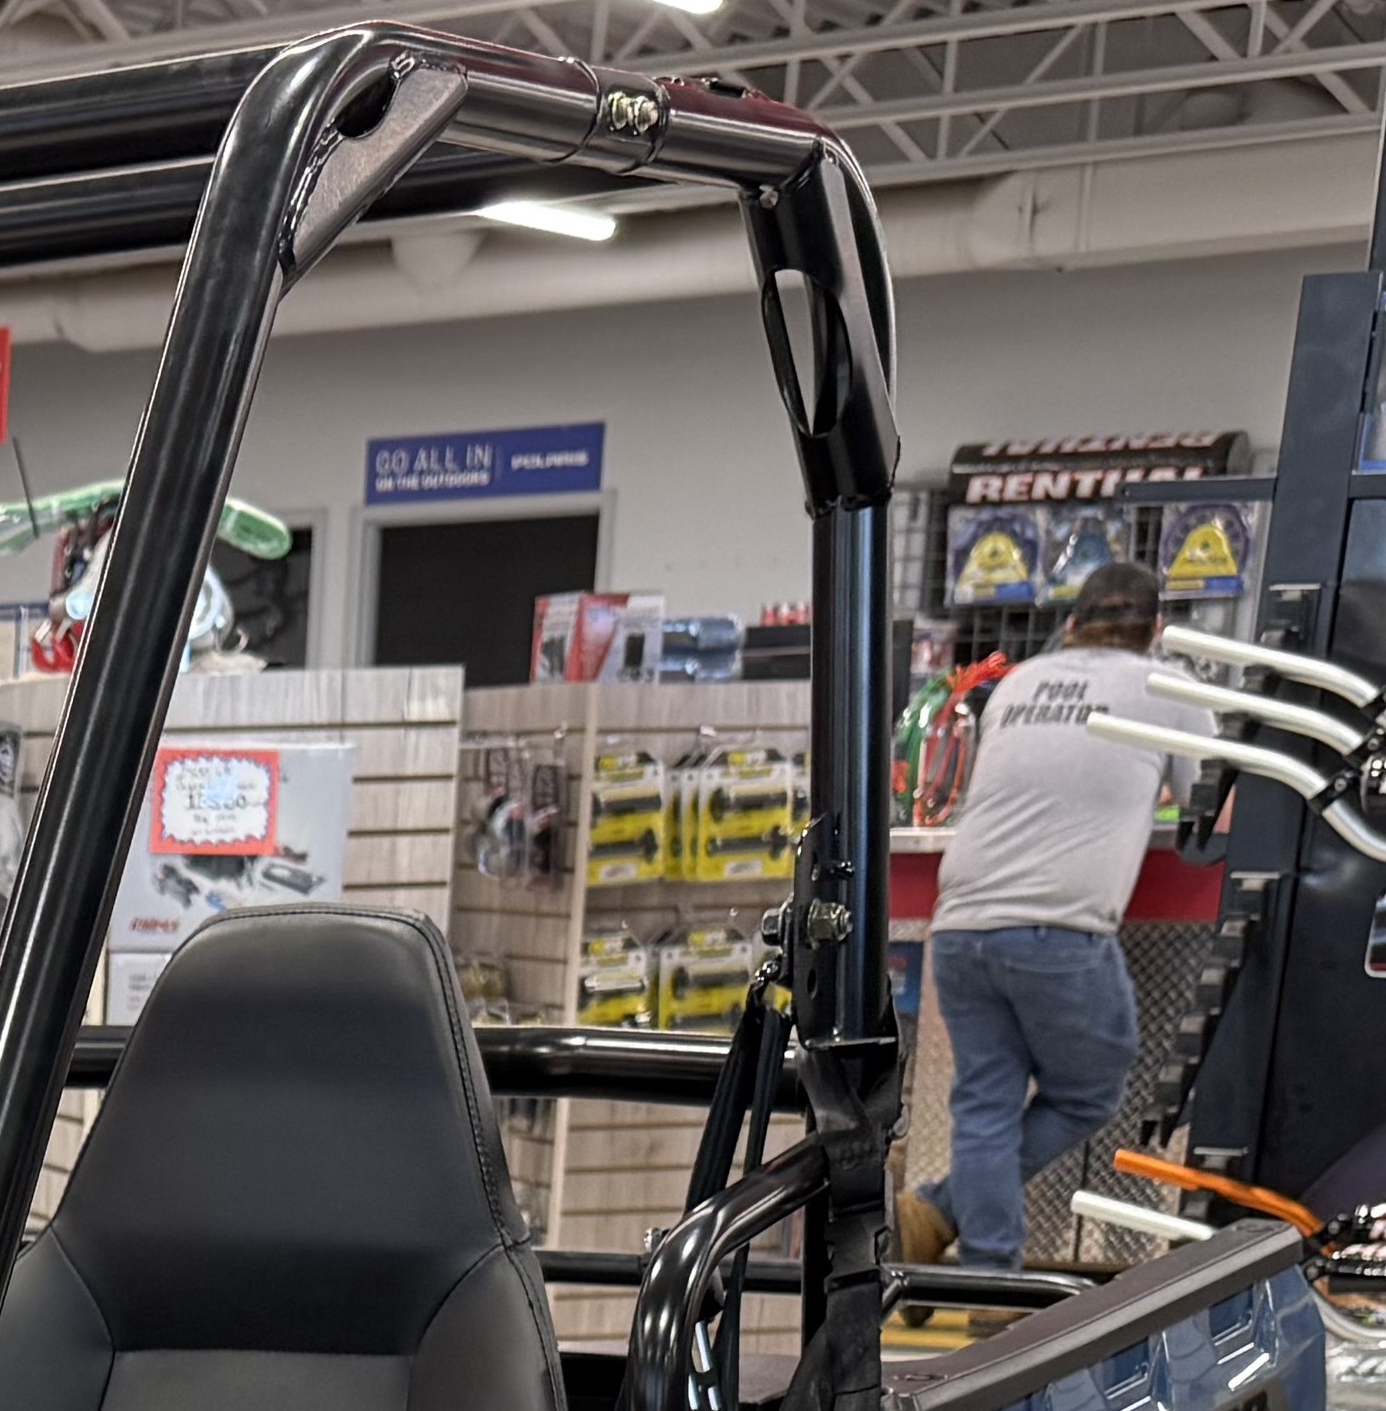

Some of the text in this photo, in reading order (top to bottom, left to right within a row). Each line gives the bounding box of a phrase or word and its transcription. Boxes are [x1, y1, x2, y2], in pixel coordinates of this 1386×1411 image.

[375, 447, 410, 473] GO
[413, 444, 458, 472] ALL
[465, 442, 493, 470] IN
